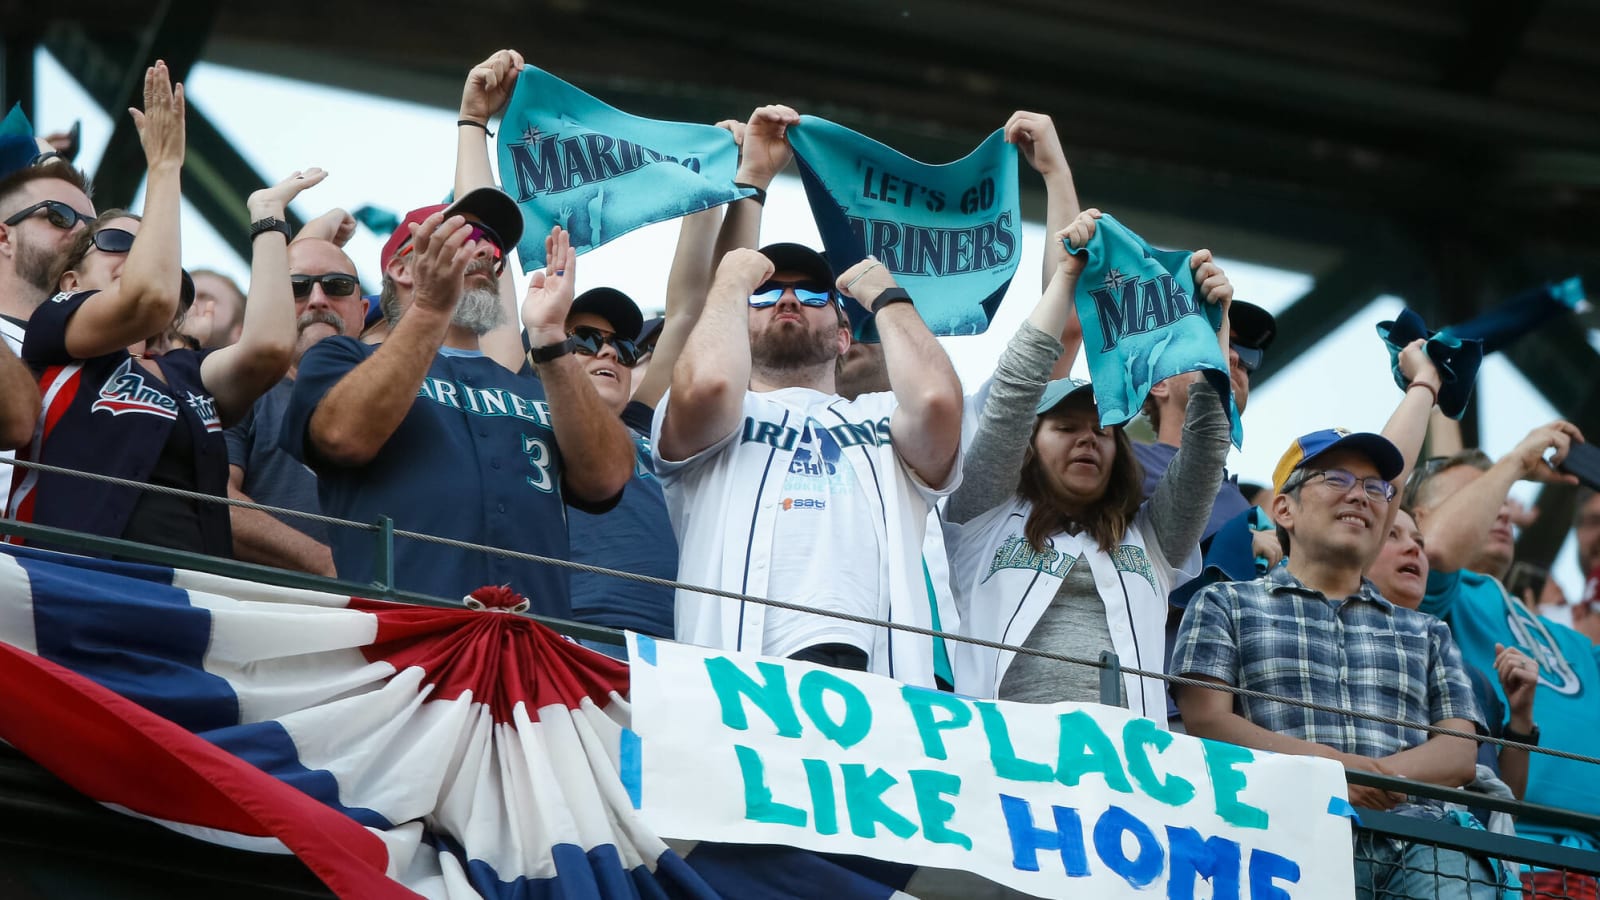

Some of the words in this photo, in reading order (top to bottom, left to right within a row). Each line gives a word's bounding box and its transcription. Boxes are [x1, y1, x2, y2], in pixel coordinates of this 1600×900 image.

[863, 167, 946, 213] LET'S
[960, 177, 996, 215] GO
[521, 433, 555, 494] 3
[704, 656, 873, 750] NO
[901, 685, 1269, 830] PLACE
[734, 744, 972, 851] LIKE
[999, 793, 1301, 900] HOME
